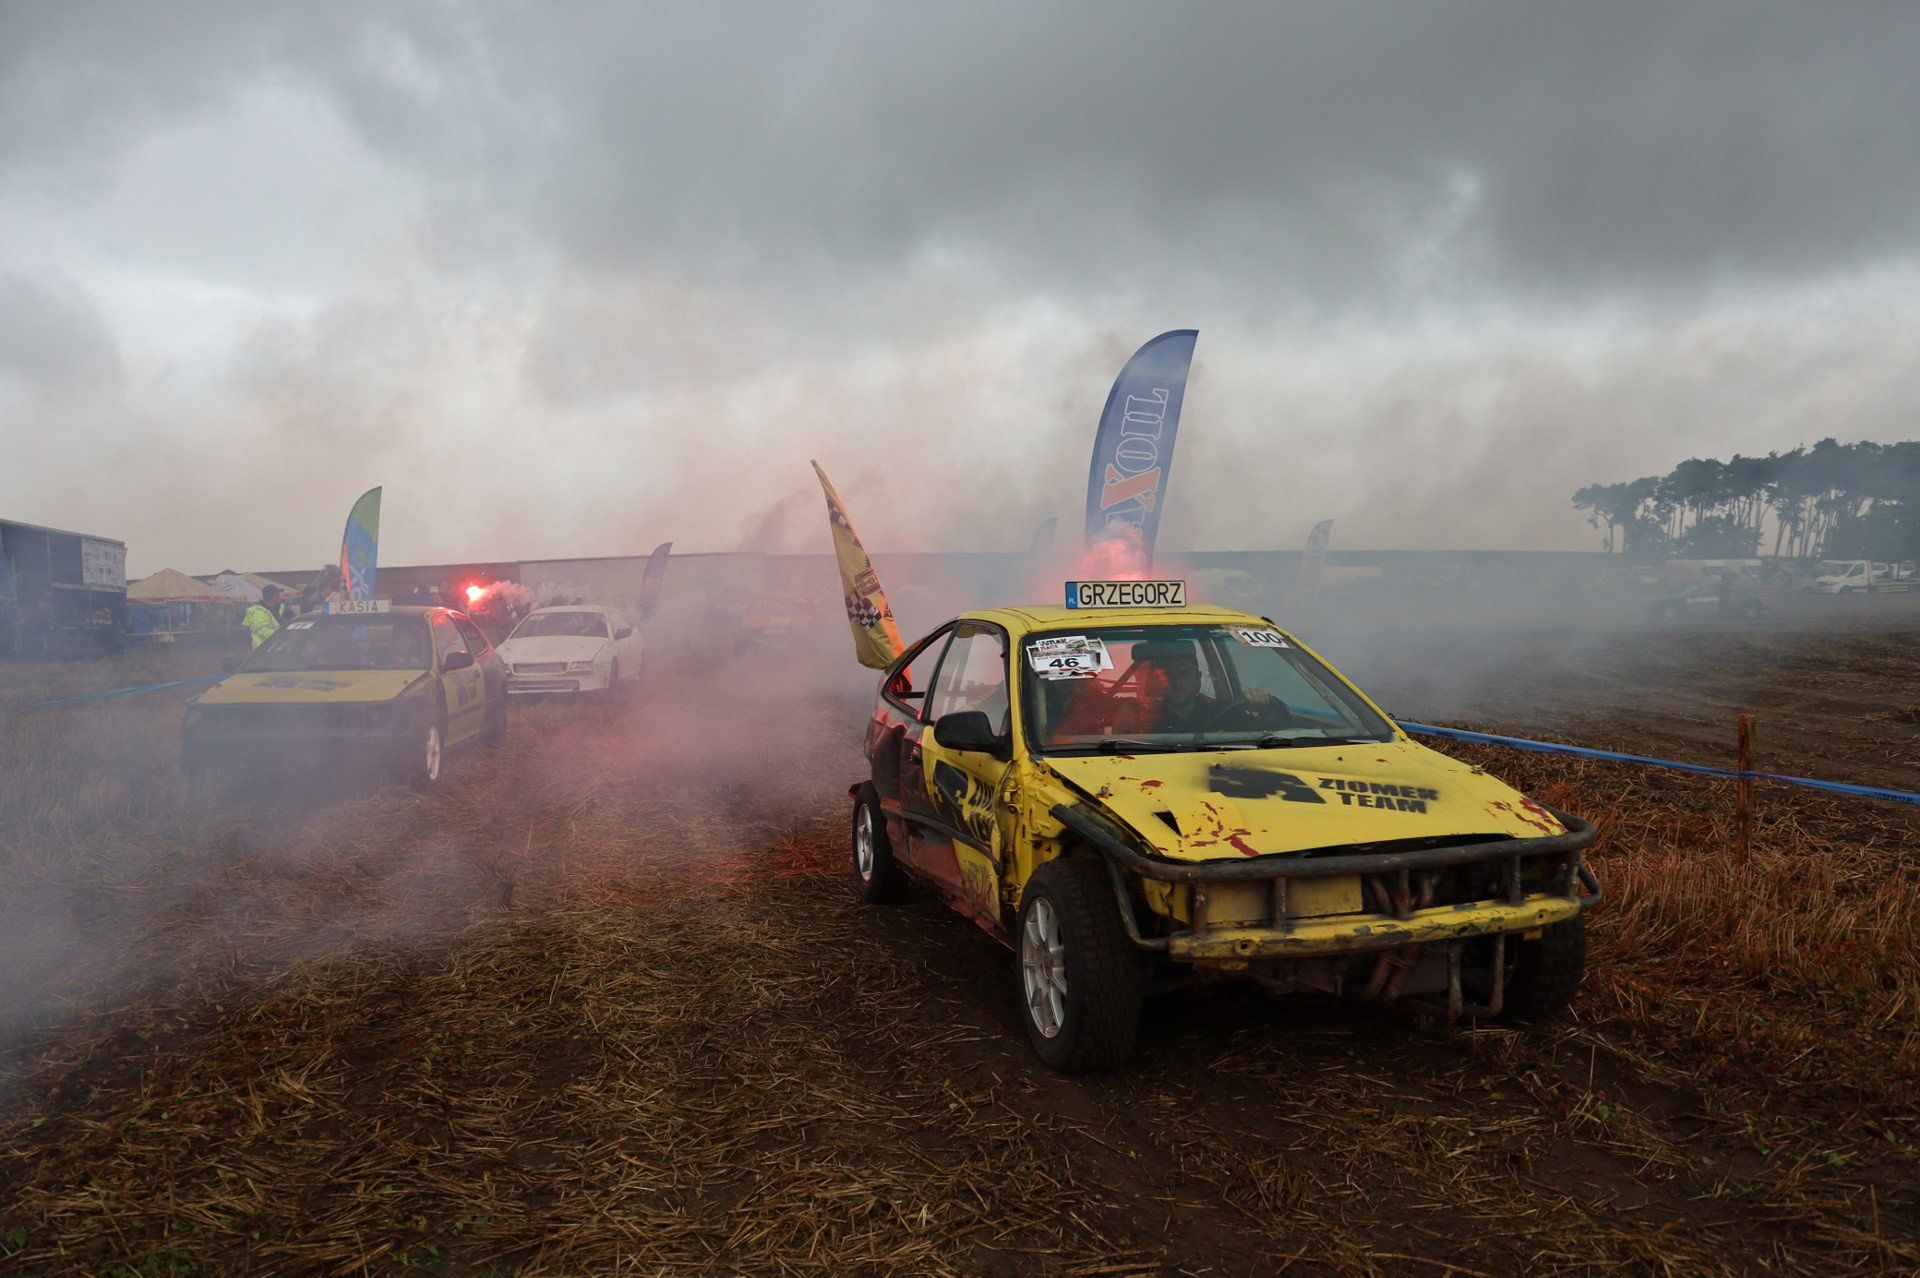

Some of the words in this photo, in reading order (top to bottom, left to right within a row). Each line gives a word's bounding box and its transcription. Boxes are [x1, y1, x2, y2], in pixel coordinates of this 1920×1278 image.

[1080, 582, 1182, 606] GRZEGORZ
[339, 600, 379, 614] KASIA
[1241, 631, 1283, 644] 100
[1049, 657, 1080, 668] 46
[1336, 792, 1428, 815] TEAM
